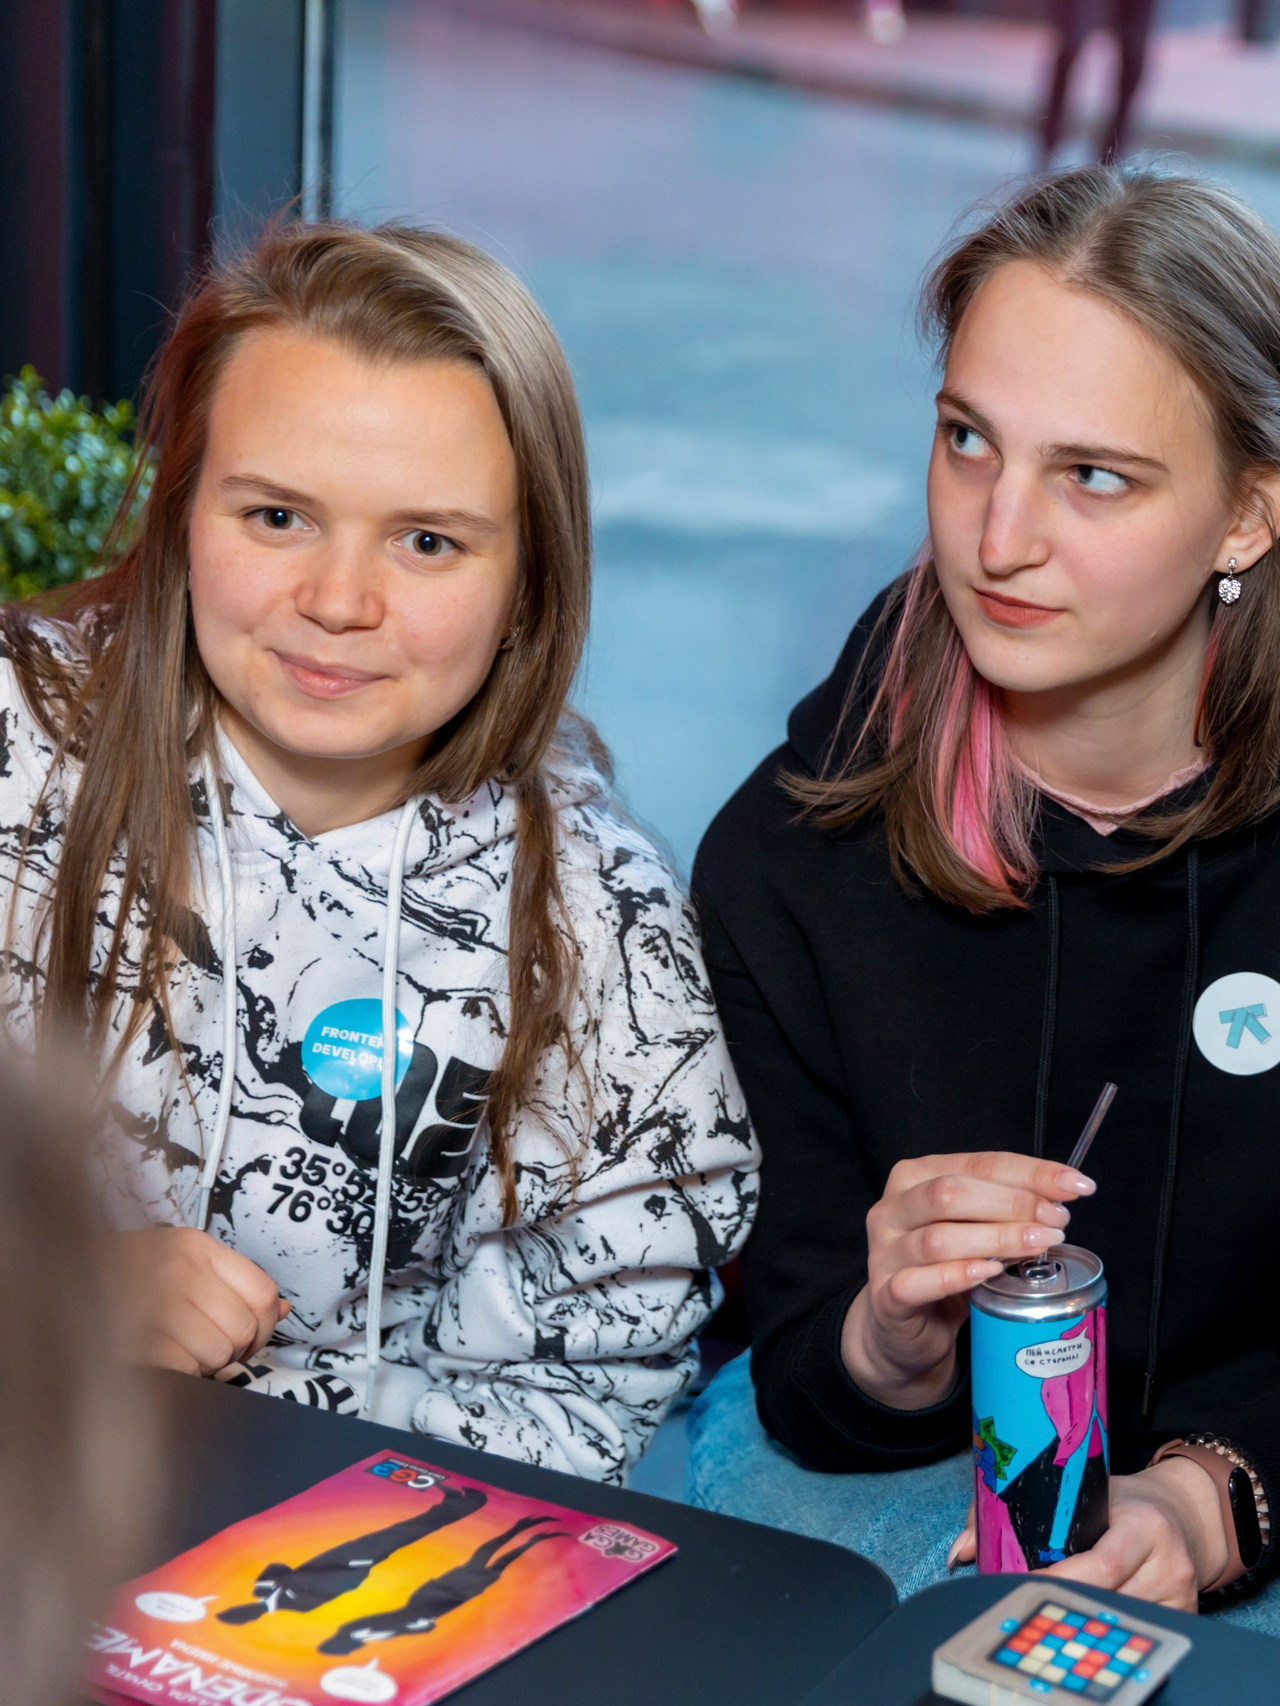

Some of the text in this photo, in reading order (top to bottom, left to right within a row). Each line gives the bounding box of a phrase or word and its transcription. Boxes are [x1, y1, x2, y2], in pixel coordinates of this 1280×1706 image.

[321, 1026, 384, 1049] FRONTEN
[312, 1042, 384, 1073] DEVELOPE
[594, 1524, 656, 1553] GAMES
